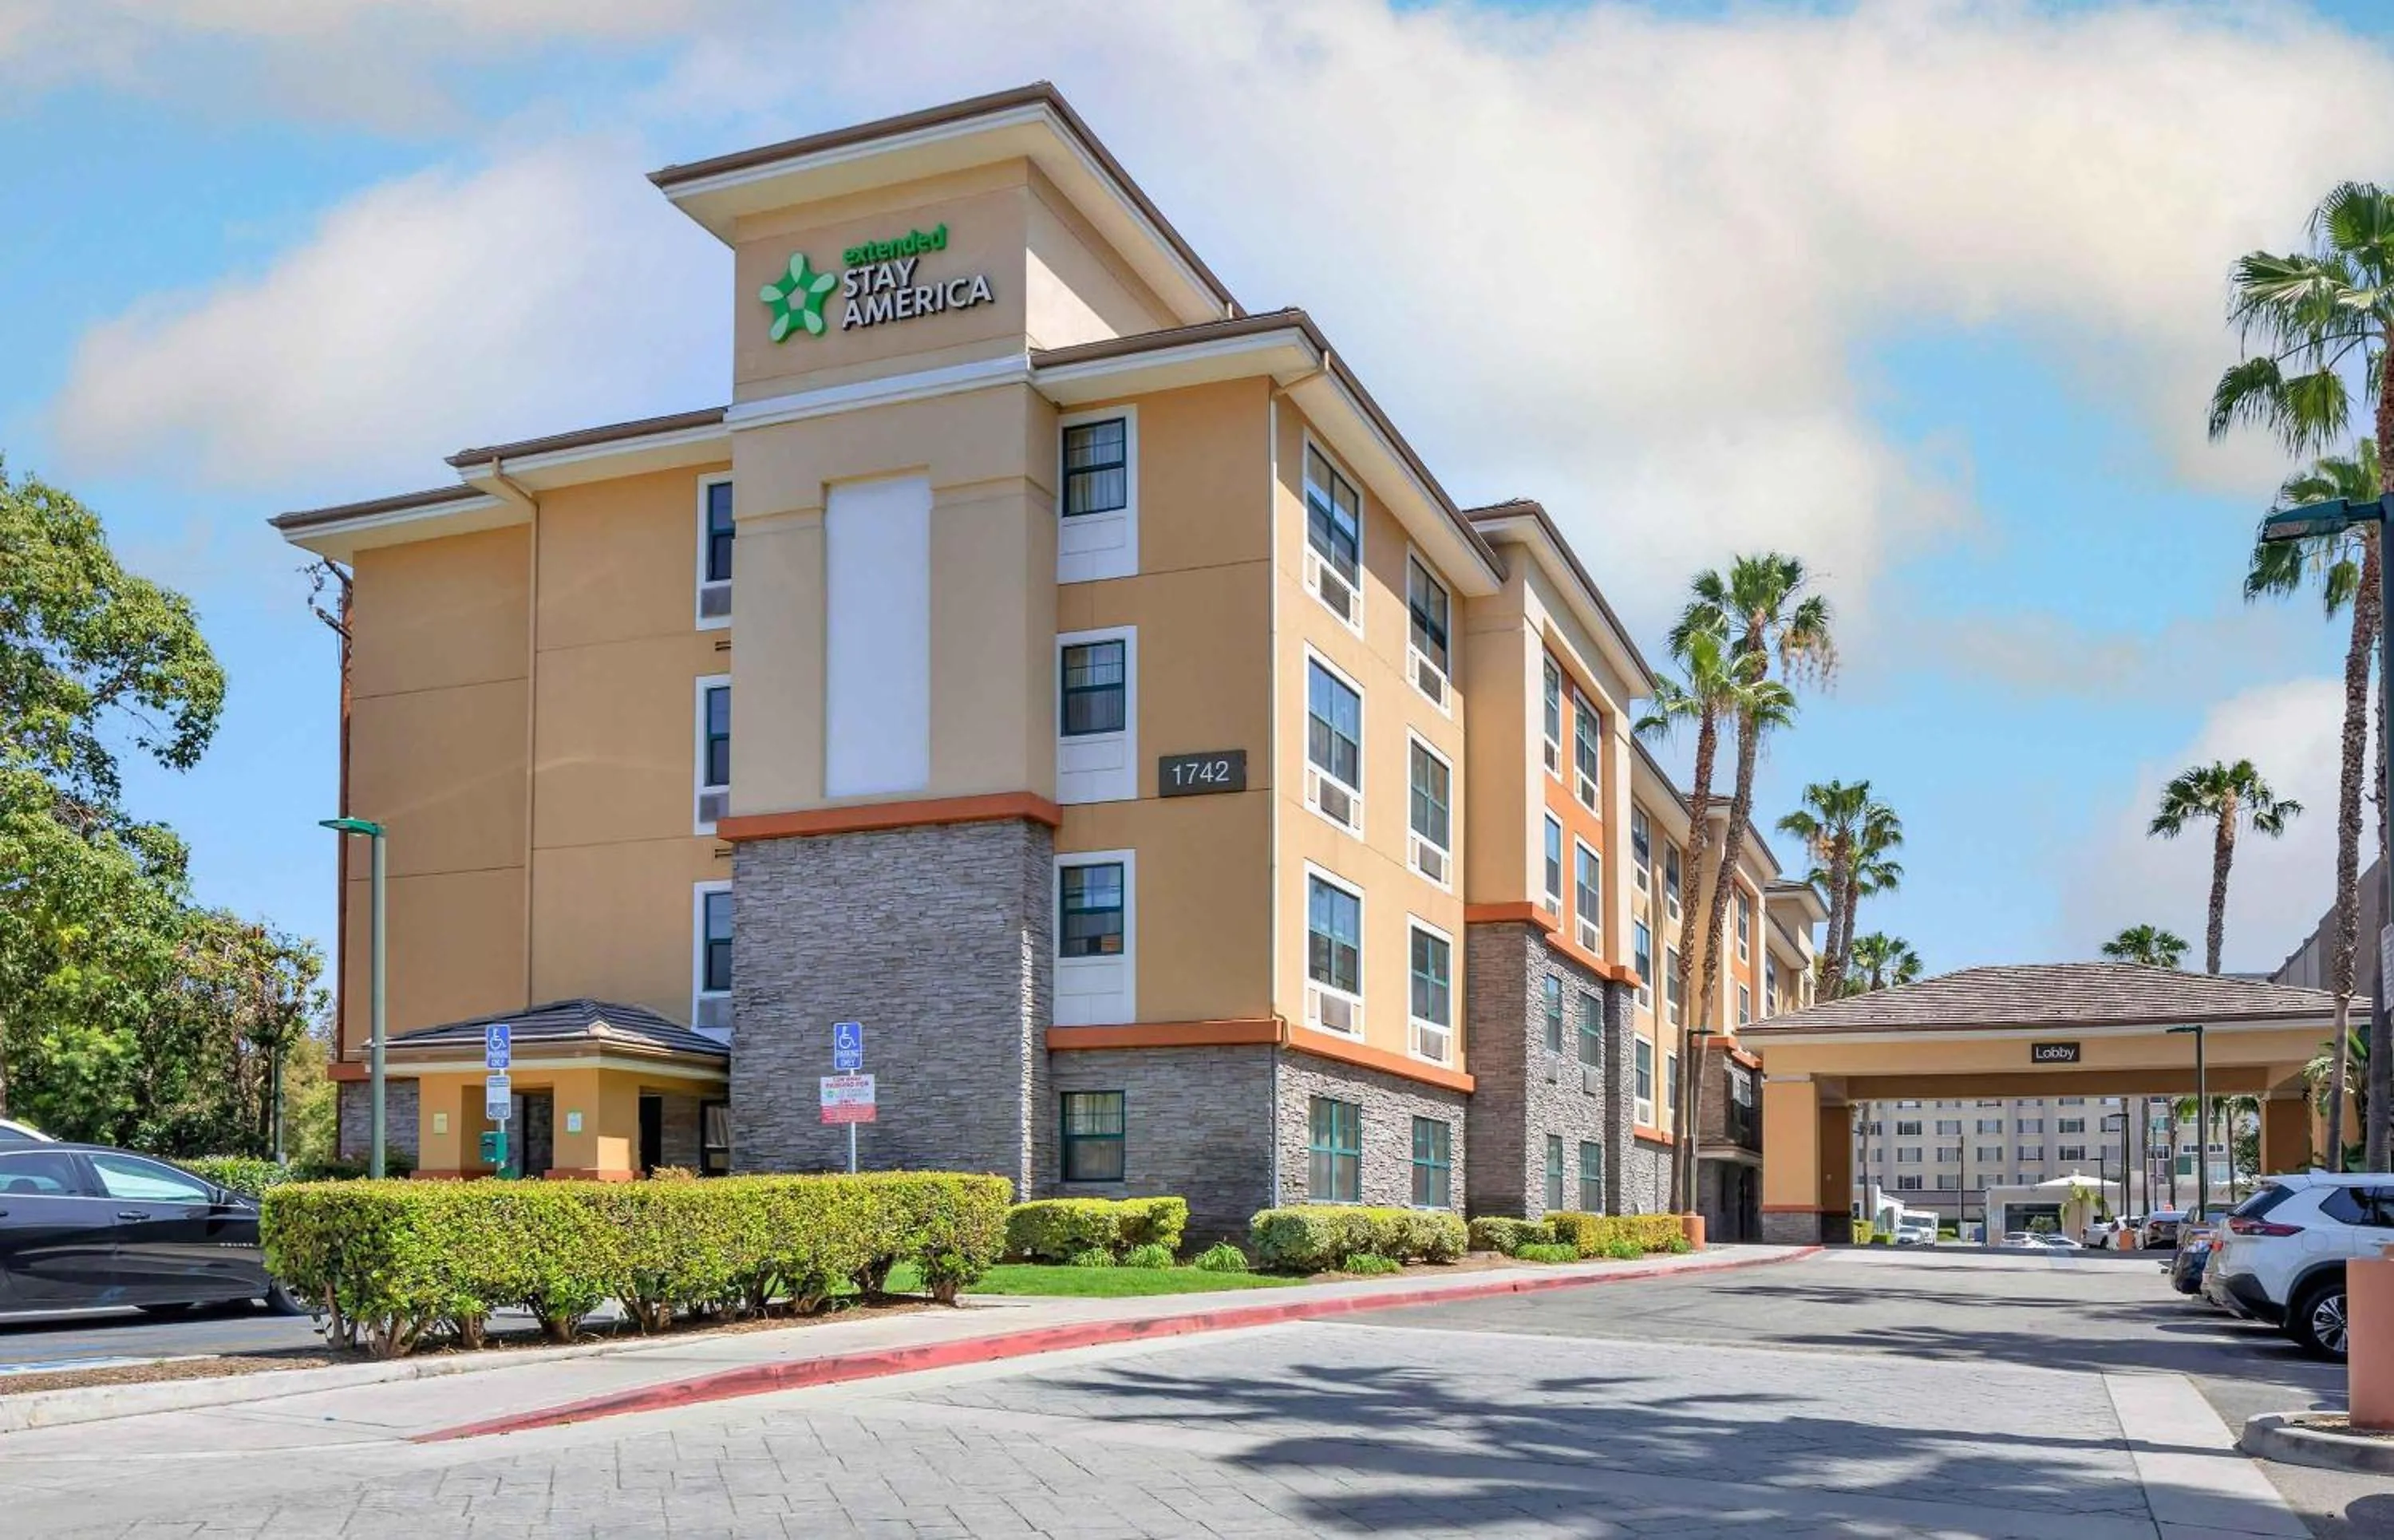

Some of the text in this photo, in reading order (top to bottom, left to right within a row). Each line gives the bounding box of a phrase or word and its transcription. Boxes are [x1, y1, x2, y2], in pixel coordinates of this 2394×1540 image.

[842, 223, 947, 266] extended
[842, 257, 918, 298] STAY
[842, 274, 994, 330] AMERICA
[1171, 760, 1230, 786] 1742
[2036, 1046, 2075, 1060] Lobby
